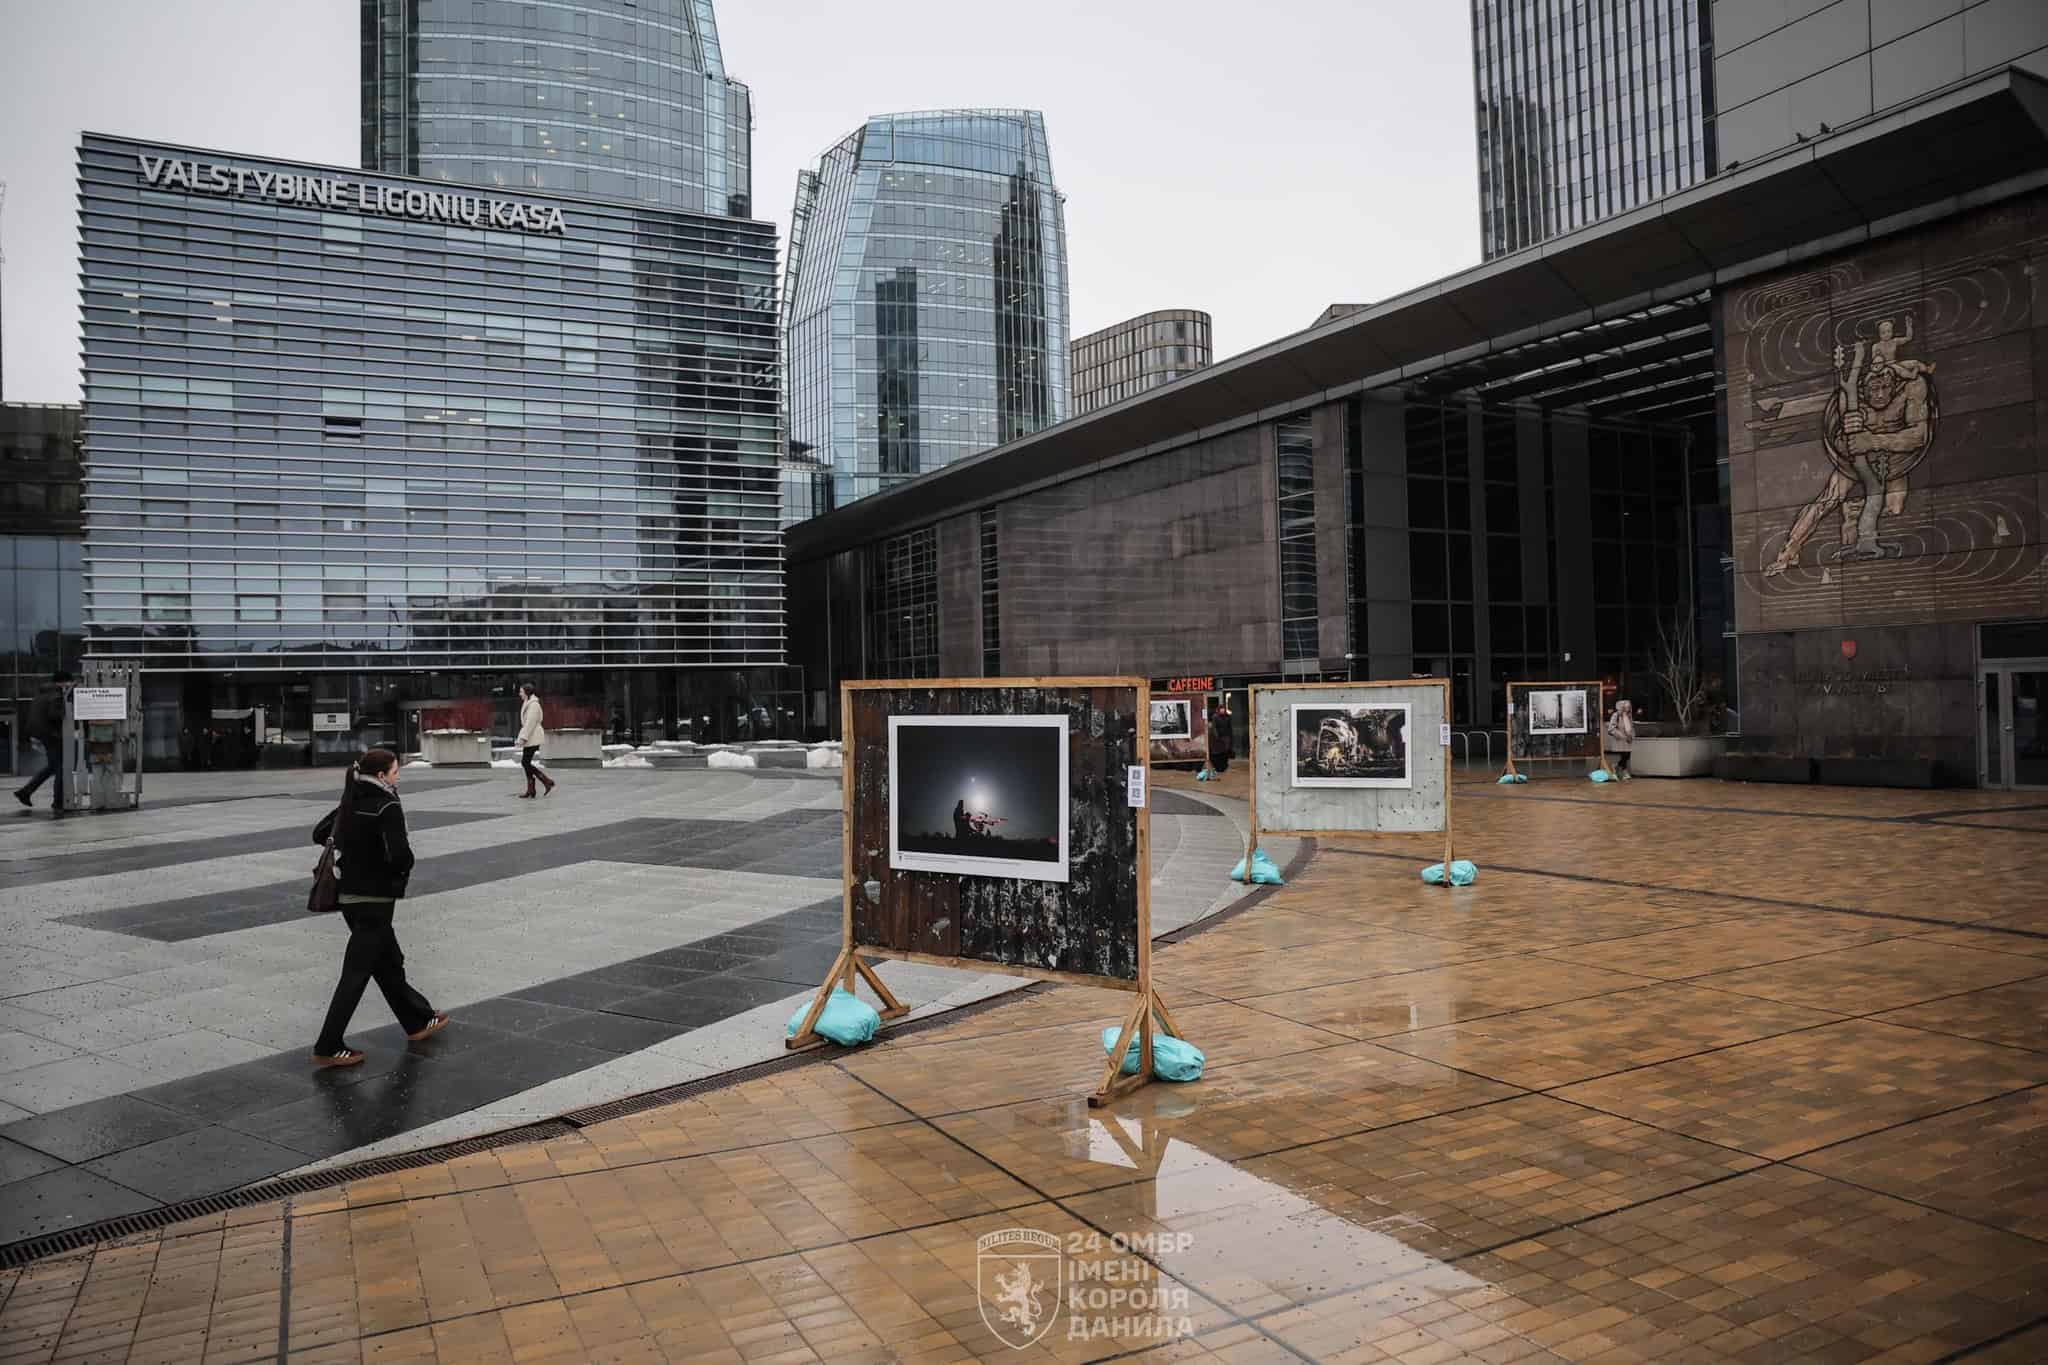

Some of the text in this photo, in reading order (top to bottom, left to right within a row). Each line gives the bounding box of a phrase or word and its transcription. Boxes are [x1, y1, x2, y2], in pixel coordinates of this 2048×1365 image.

[139, 154, 567, 233] VALSTYBINĖ LIGONIŲ KASA
[1168, 677, 1214, 691] CAFFEINE
